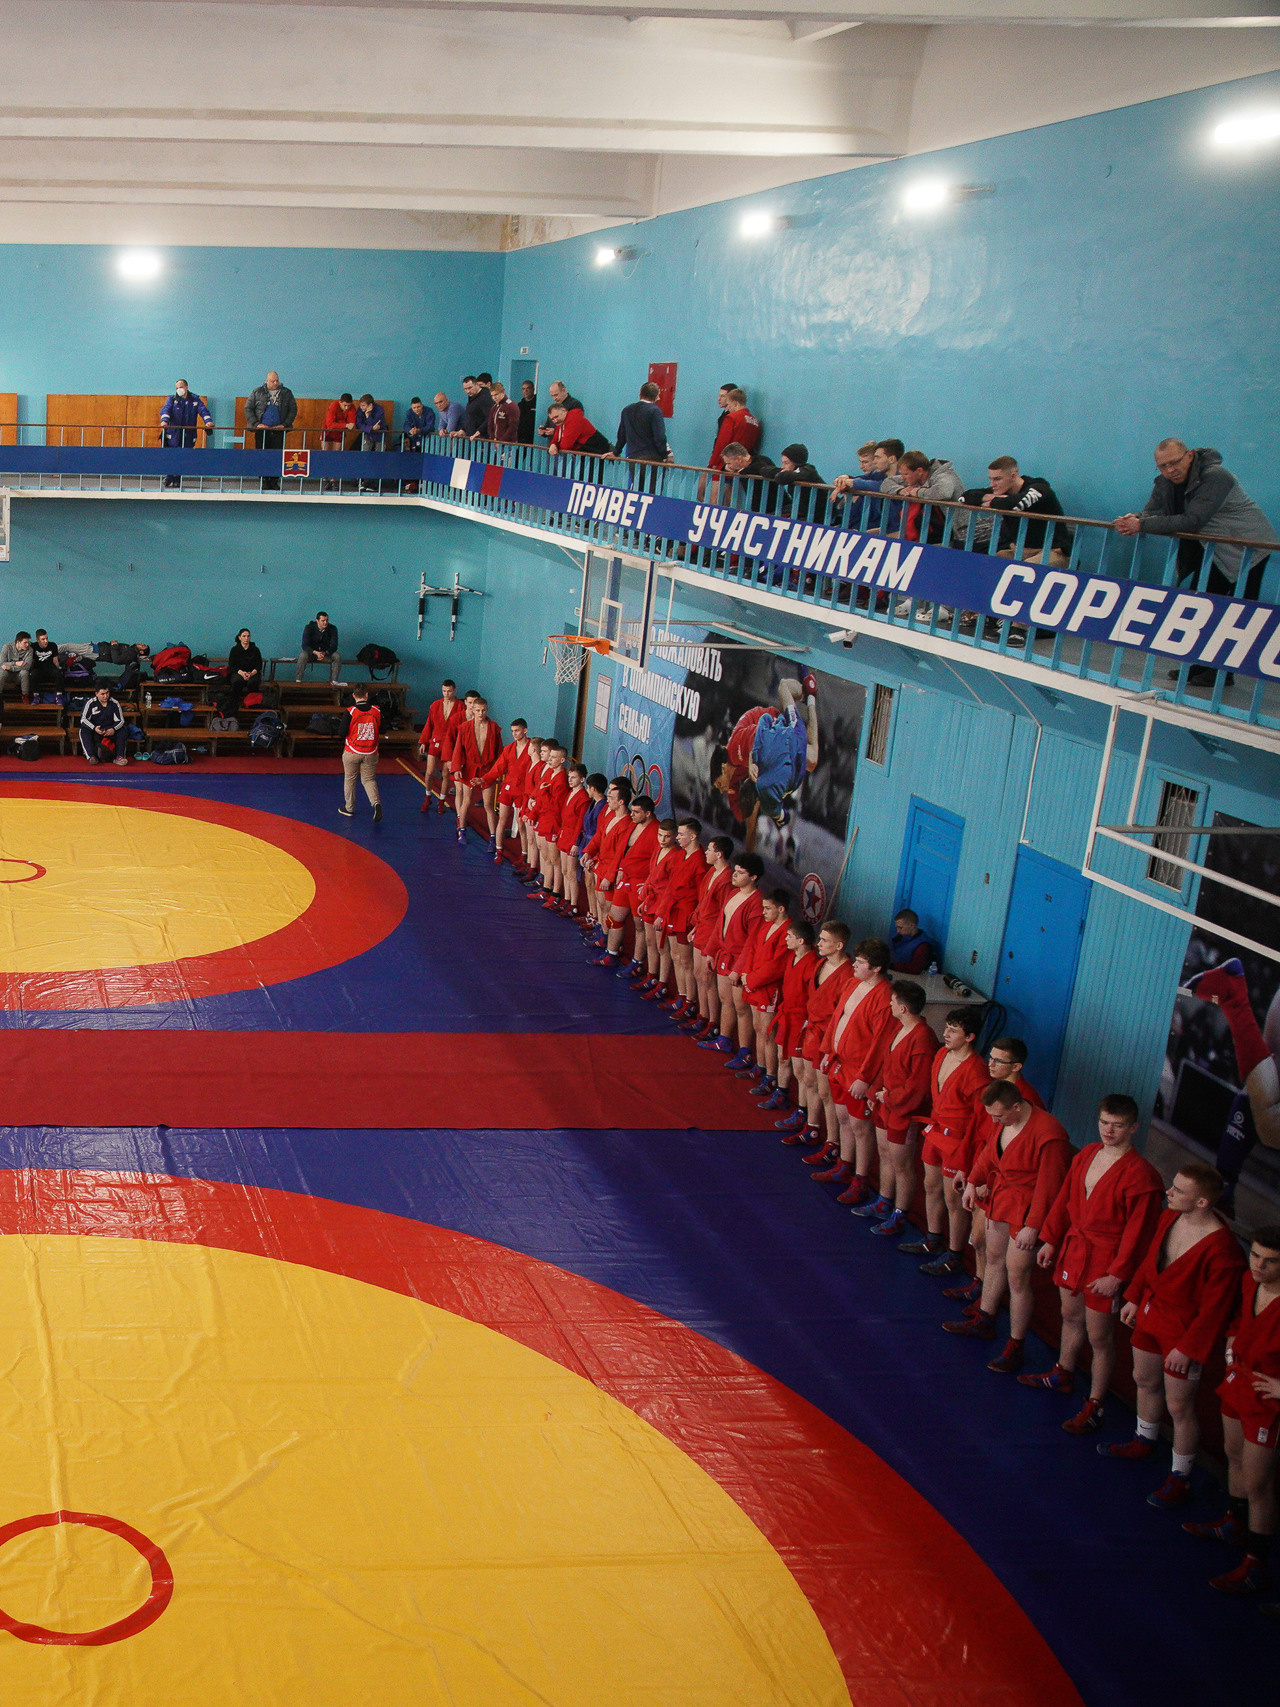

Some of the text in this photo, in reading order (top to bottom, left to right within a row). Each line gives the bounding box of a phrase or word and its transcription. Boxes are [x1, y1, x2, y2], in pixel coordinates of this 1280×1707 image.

[567, 482, 654, 530] ПРИВЕТ
[688, 504, 924, 592] УЧАСТНИКАМ
[629, 667, 701, 722] ОЛИМПИЙСКУЮ
[618, 702, 652, 745] СЕМЬЮ!
